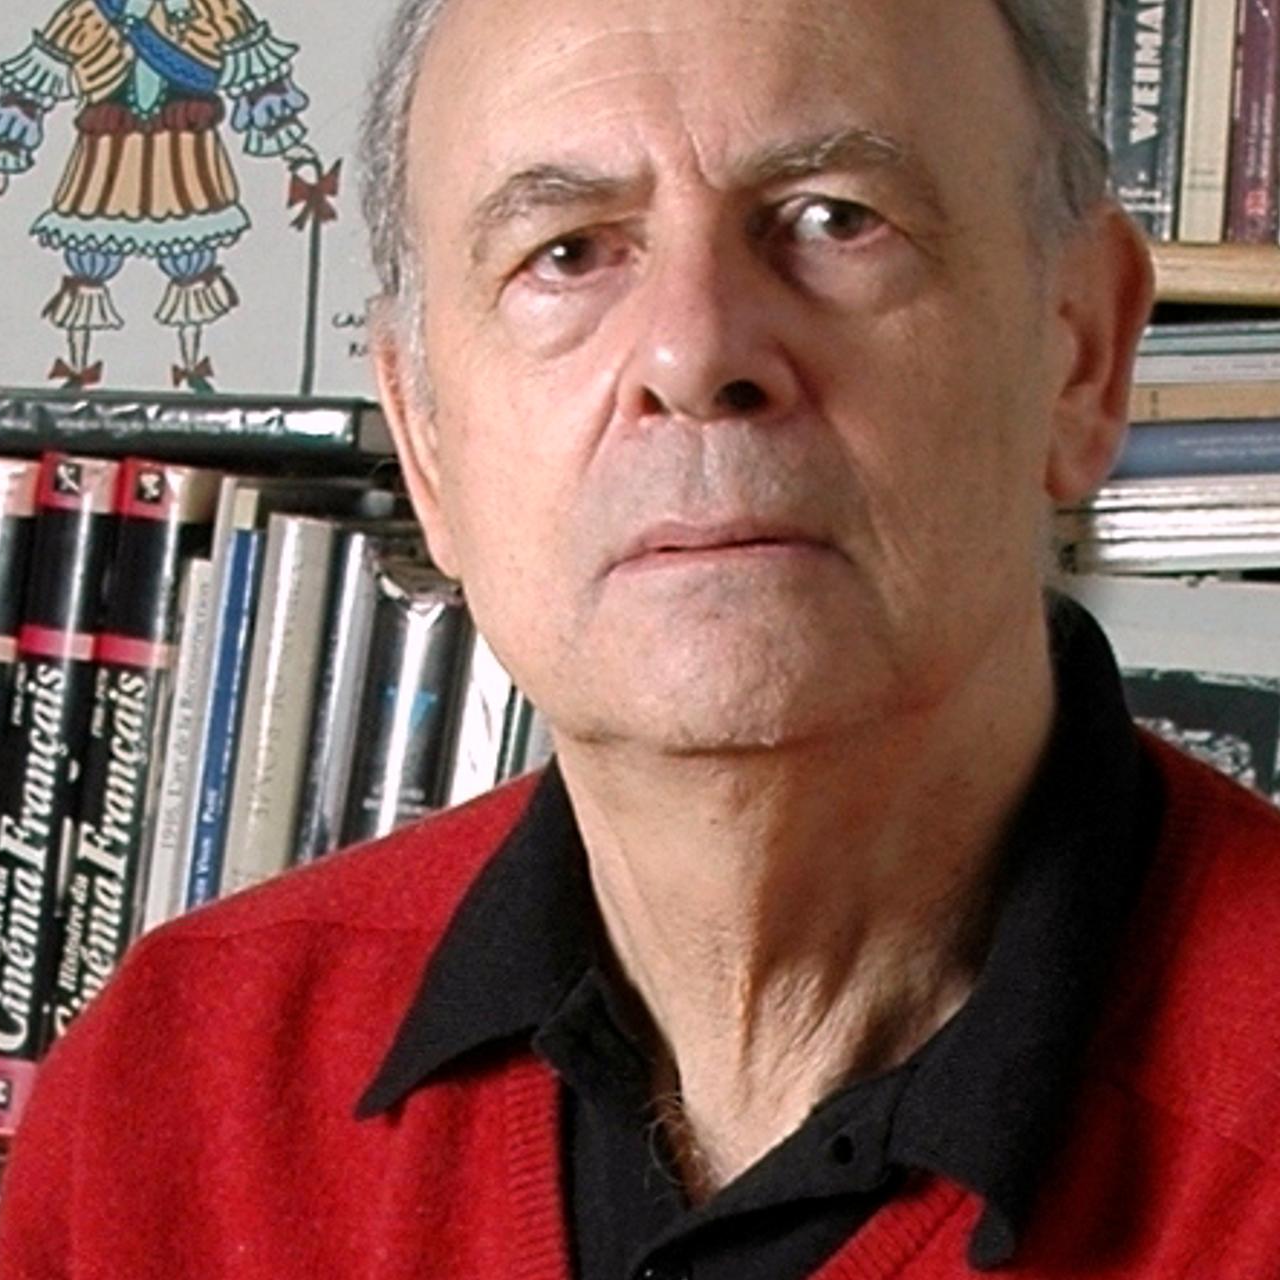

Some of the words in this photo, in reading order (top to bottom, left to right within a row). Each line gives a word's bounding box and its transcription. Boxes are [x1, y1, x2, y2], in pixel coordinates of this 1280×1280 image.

[1128, 0, 1166, 144] WEIMA
[78, 672, 149, 874] Français
[70, 873, 91, 904] du
[58, 903, 85, 991] Histoire
